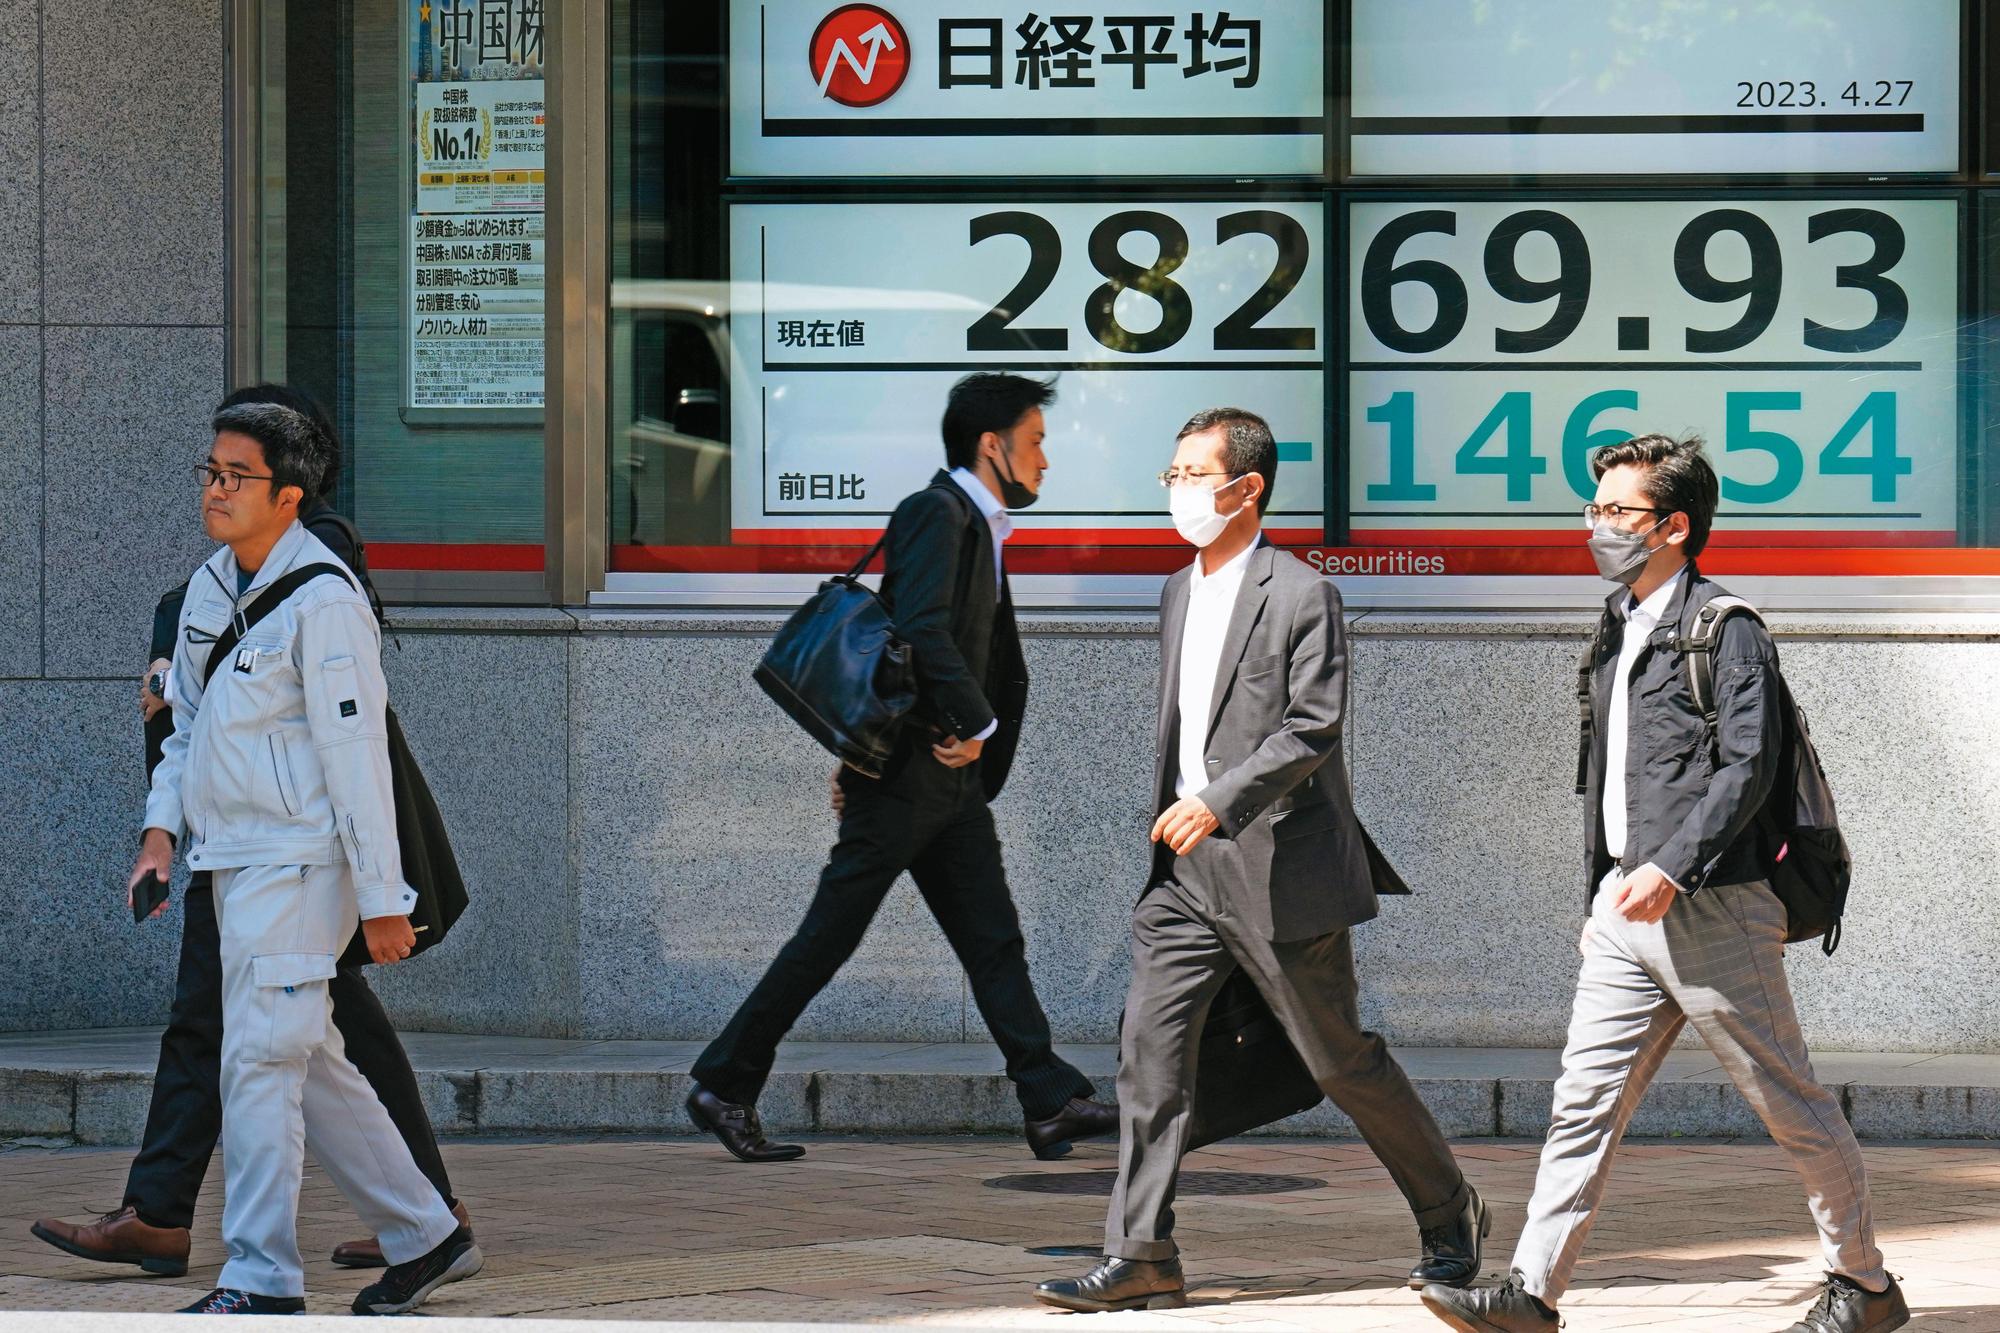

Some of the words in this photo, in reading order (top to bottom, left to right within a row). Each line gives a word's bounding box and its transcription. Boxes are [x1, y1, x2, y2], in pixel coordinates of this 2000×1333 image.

[439, 0, 544, 67] 中国株
[938, 12, 1261, 90] 日経平均
[443, 89, 469, 105] 中国株
[1736, 81, 1826, 107] 2023.
[1840, 80, 1914, 106] 4.27
[433, 107, 478, 123] 取扱銘柄数
[433, 128, 481, 161] No.1!
[416, 268, 518, 286] 取引時間中の注文が可能
[416, 293, 481, 311] 分別管理で安心
[416, 318, 487, 336] ノウハウと人材力
[777, 320, 865, 348] 現在値
[778, 472, 865, 501] 前日比
[1306, 550, 1445, 574] Securities
